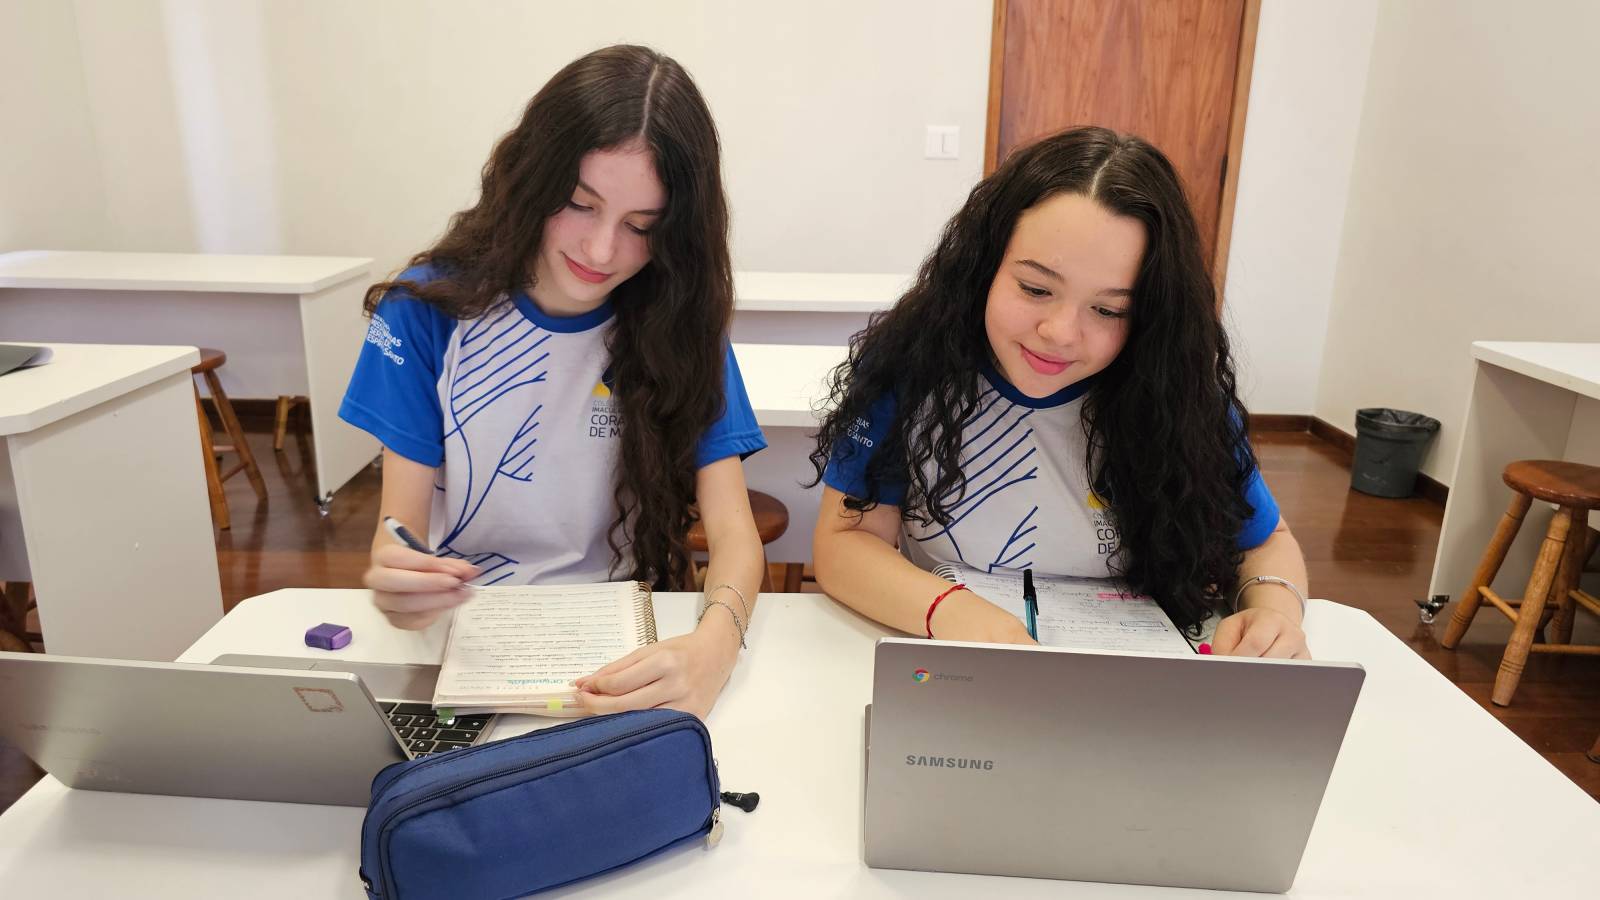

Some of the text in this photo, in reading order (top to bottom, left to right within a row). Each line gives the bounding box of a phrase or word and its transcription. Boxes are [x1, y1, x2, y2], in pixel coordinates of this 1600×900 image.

[591, 414, 624, 426] CORA
[589, 426, 624, 438] DE M
[1097, 543, 1115, 555] DE
[933, 672, 975, 683] chrome
[905, 754, 994, 771] SAMSUNG
